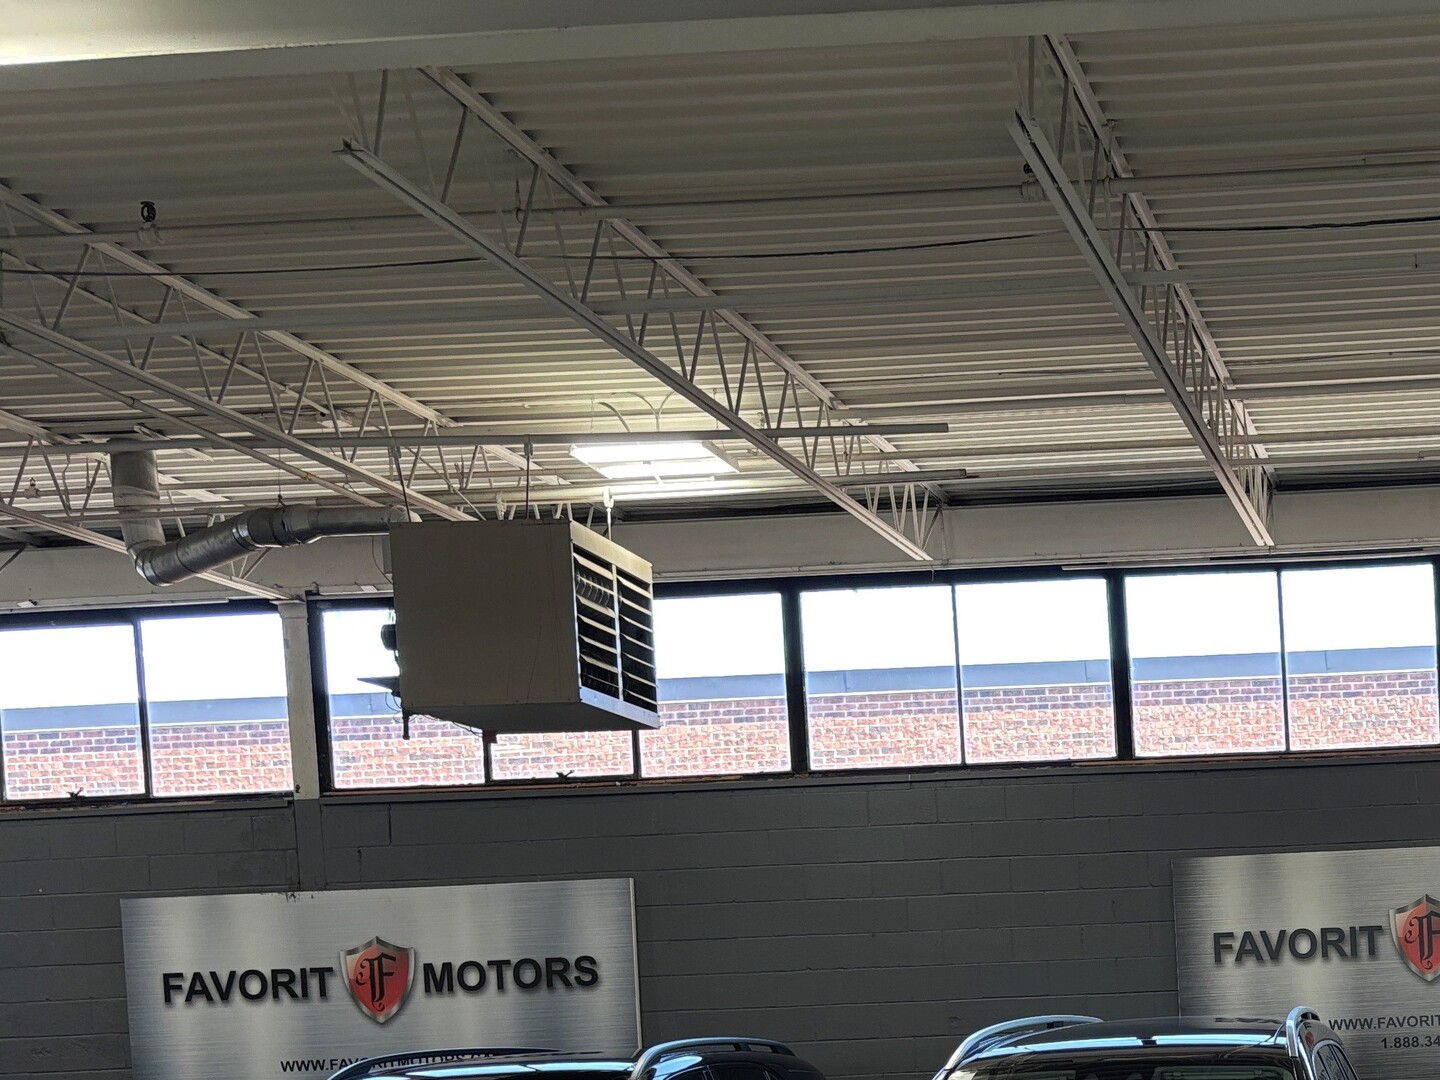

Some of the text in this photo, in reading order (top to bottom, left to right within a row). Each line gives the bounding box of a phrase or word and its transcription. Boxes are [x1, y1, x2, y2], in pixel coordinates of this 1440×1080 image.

[1212, 924, 1383, 963] FAVORIT
[162, 966, 334, 1004] FAVORIT
[423, 954, 599, 994] MOTORS
